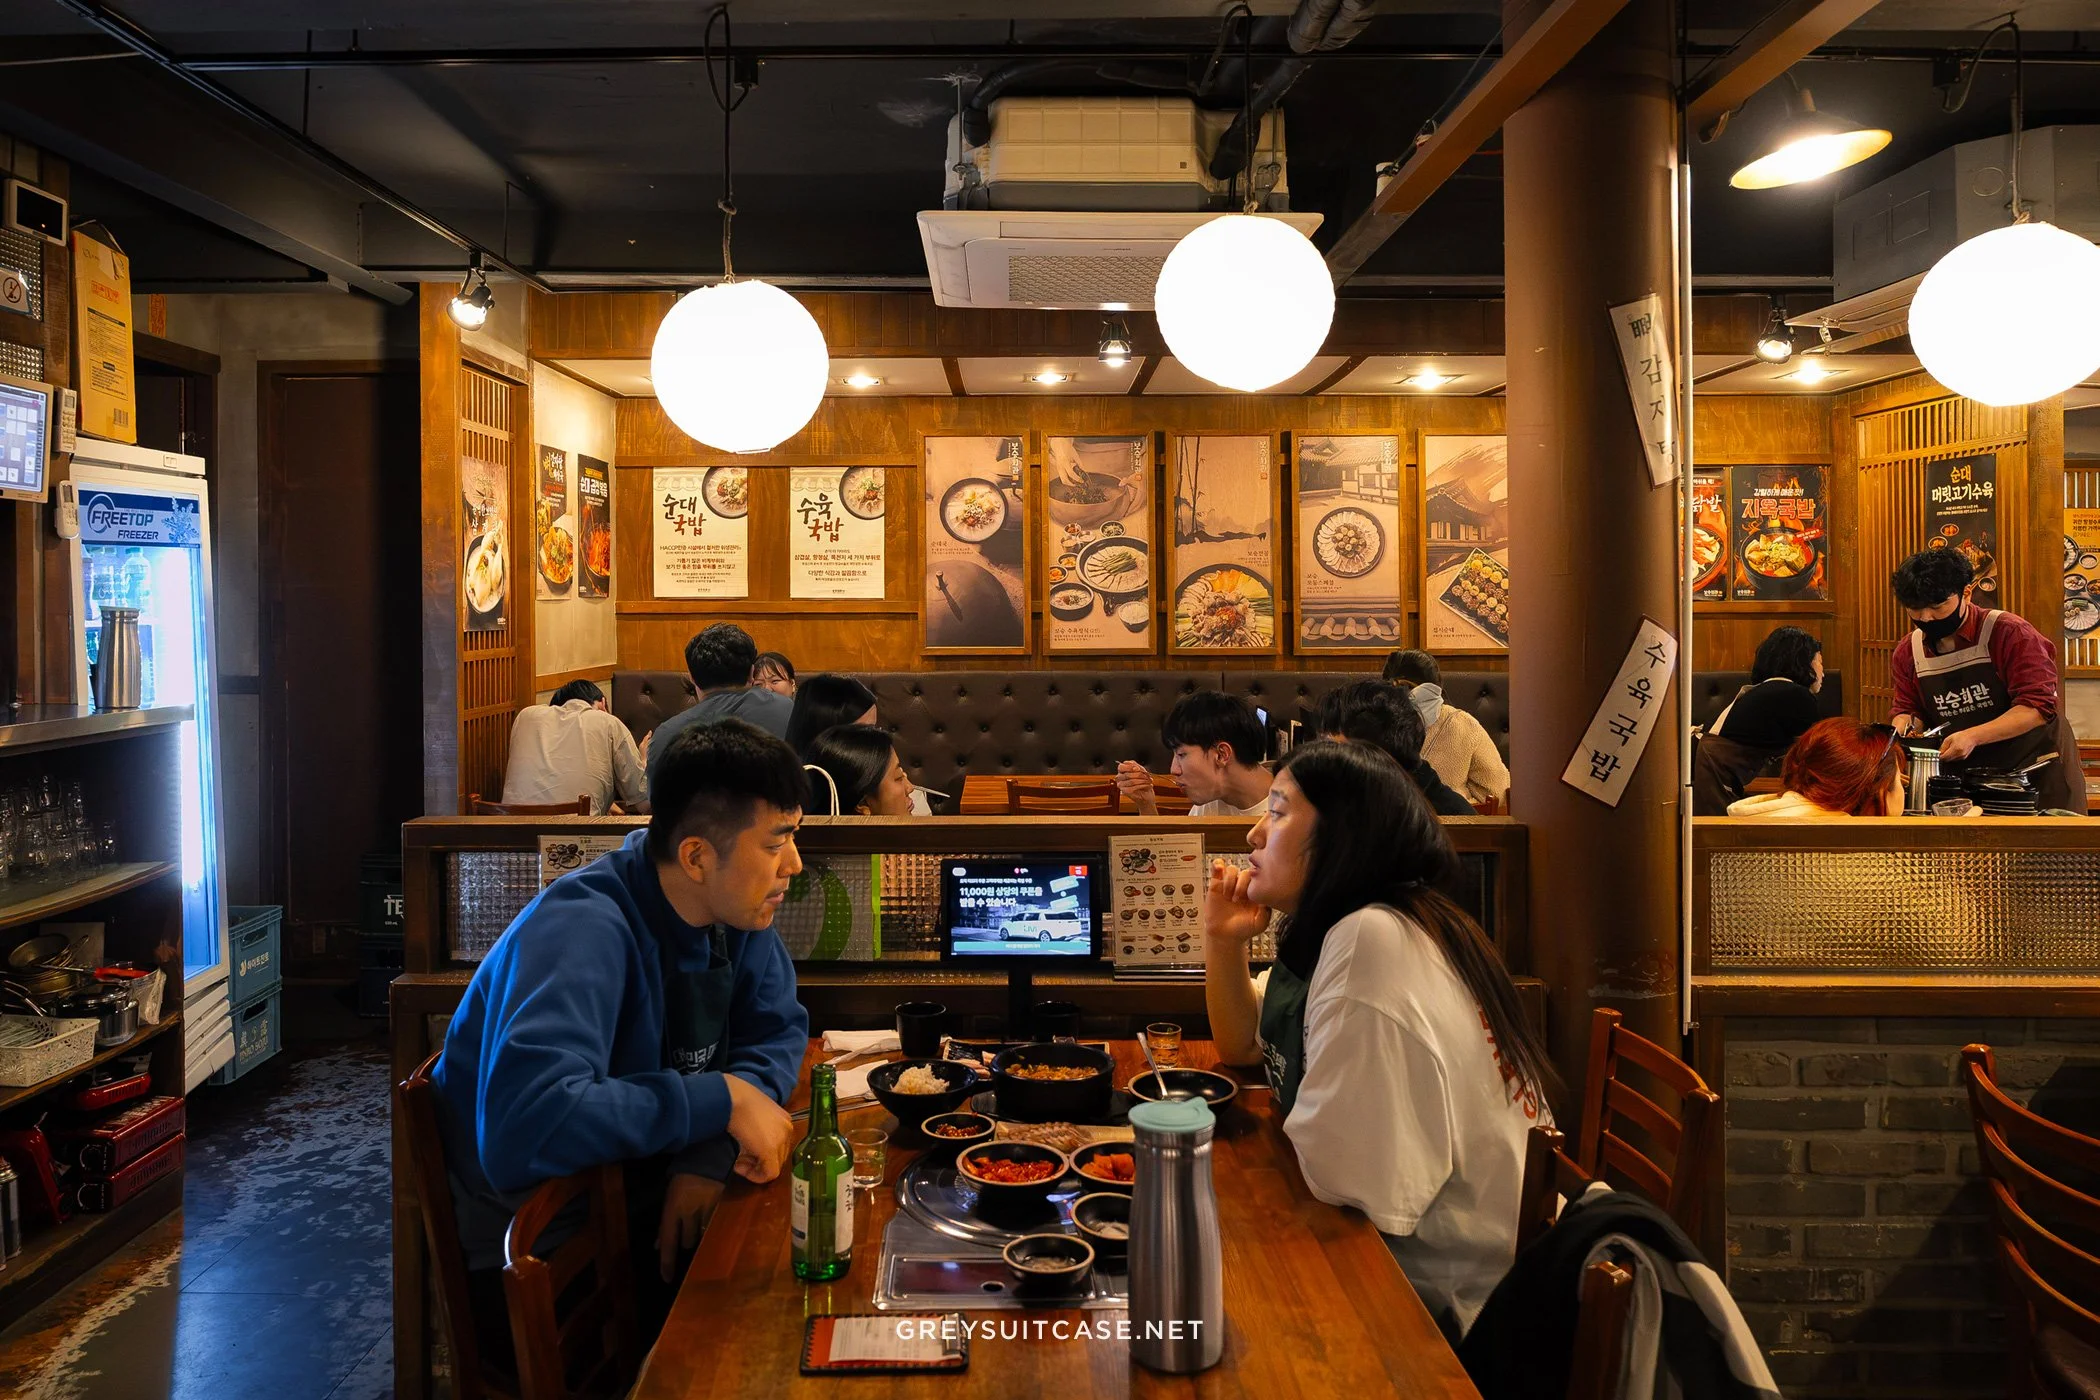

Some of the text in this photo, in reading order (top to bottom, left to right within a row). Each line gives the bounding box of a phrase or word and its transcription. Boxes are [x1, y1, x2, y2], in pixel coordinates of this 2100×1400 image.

[1950, 464, 1972, 484] 순대
[1931, 481, 1994, 503] 머릿고기수육
[662, 493, 697, 519] 순대
[796, 492, 834, 524] 수육
[1741, 498, 1817, 520] 지옥국밥
[91, 509, 154, 528] FREETOP
[673, 513, 707, 537] 국밥
[117, 529, 159, 540] FREEZER
[807, 517, 845, 543] 국밥
[1933, 682, 1991, 711] 보승회관
[1589, 641, 1666, 783] 수육국밥
[959, 886, 1043, 898] 11,000원 상당의 쿠폰을
[959, 898, 1018, 908] 받을 수 있습니다.
